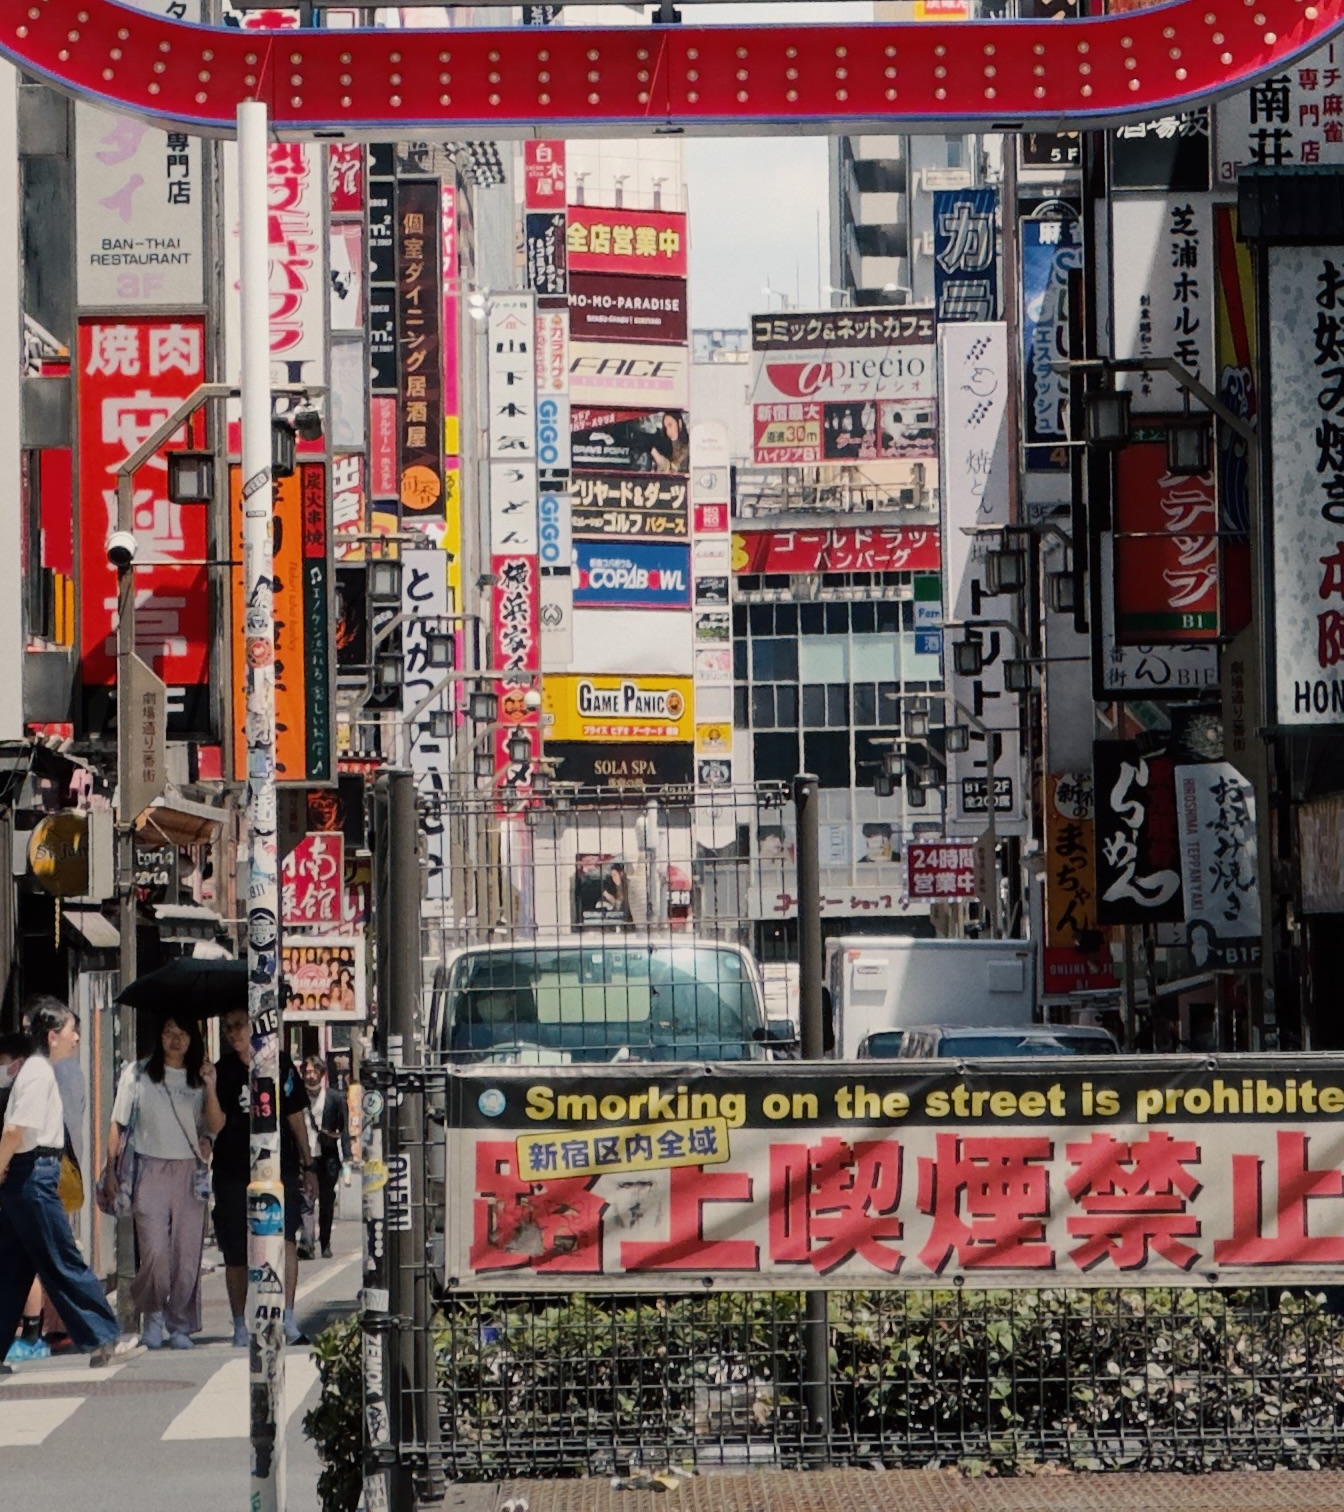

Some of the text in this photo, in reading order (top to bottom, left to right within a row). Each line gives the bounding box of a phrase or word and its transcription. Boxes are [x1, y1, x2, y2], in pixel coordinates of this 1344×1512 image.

[1298, 69, 1320, 163] 専門店
[166, 132, 191, 205] 専門店
[101, 238, 181, 250] BAN-THAI
[567, 221, 679, 258] 全店営業中
[90, 252, 192, 266] RESTAURANT
[116, 272, 165, 299] 3F
[1169, 204, 1200, 388] 芝浦ホルモ
[567, 294, 680, 312] MO-MO-PARADISE
[403, 213, 427, 447] 個室ダイニング居酒屋
[755, 316, 933, 343] コミック&ネットカフェ
[84, 324, 201, 376] 焼肉
[569, 356, 682, 378] FACE
[757, 404, 820, 422] 新宿最大
[814, 548, 911, 569] ハンバーグ
[1182, 614, 1204, 629] B1
[579, 683, 665, 714] GAME PANIC
[594, 760, 657, 775] SOLA SPA
[1182, 778, 1198, 836] HIROSHIMA
[912, 849, 975, 869] 24時間
[913, 871, 975, 894] 営業中
[1225, 947, 1262, 964] B1F
[525, 1086, 746, 1128] Smorking
[768, 1092, 826, 1119] on
[835, 1086, 909, 1119] the
[924, 1086, 1065, 1118] street
[1081, 1086, 1121, 1117] is
[527, 1126, 720, 1172] 新宿区内全域
